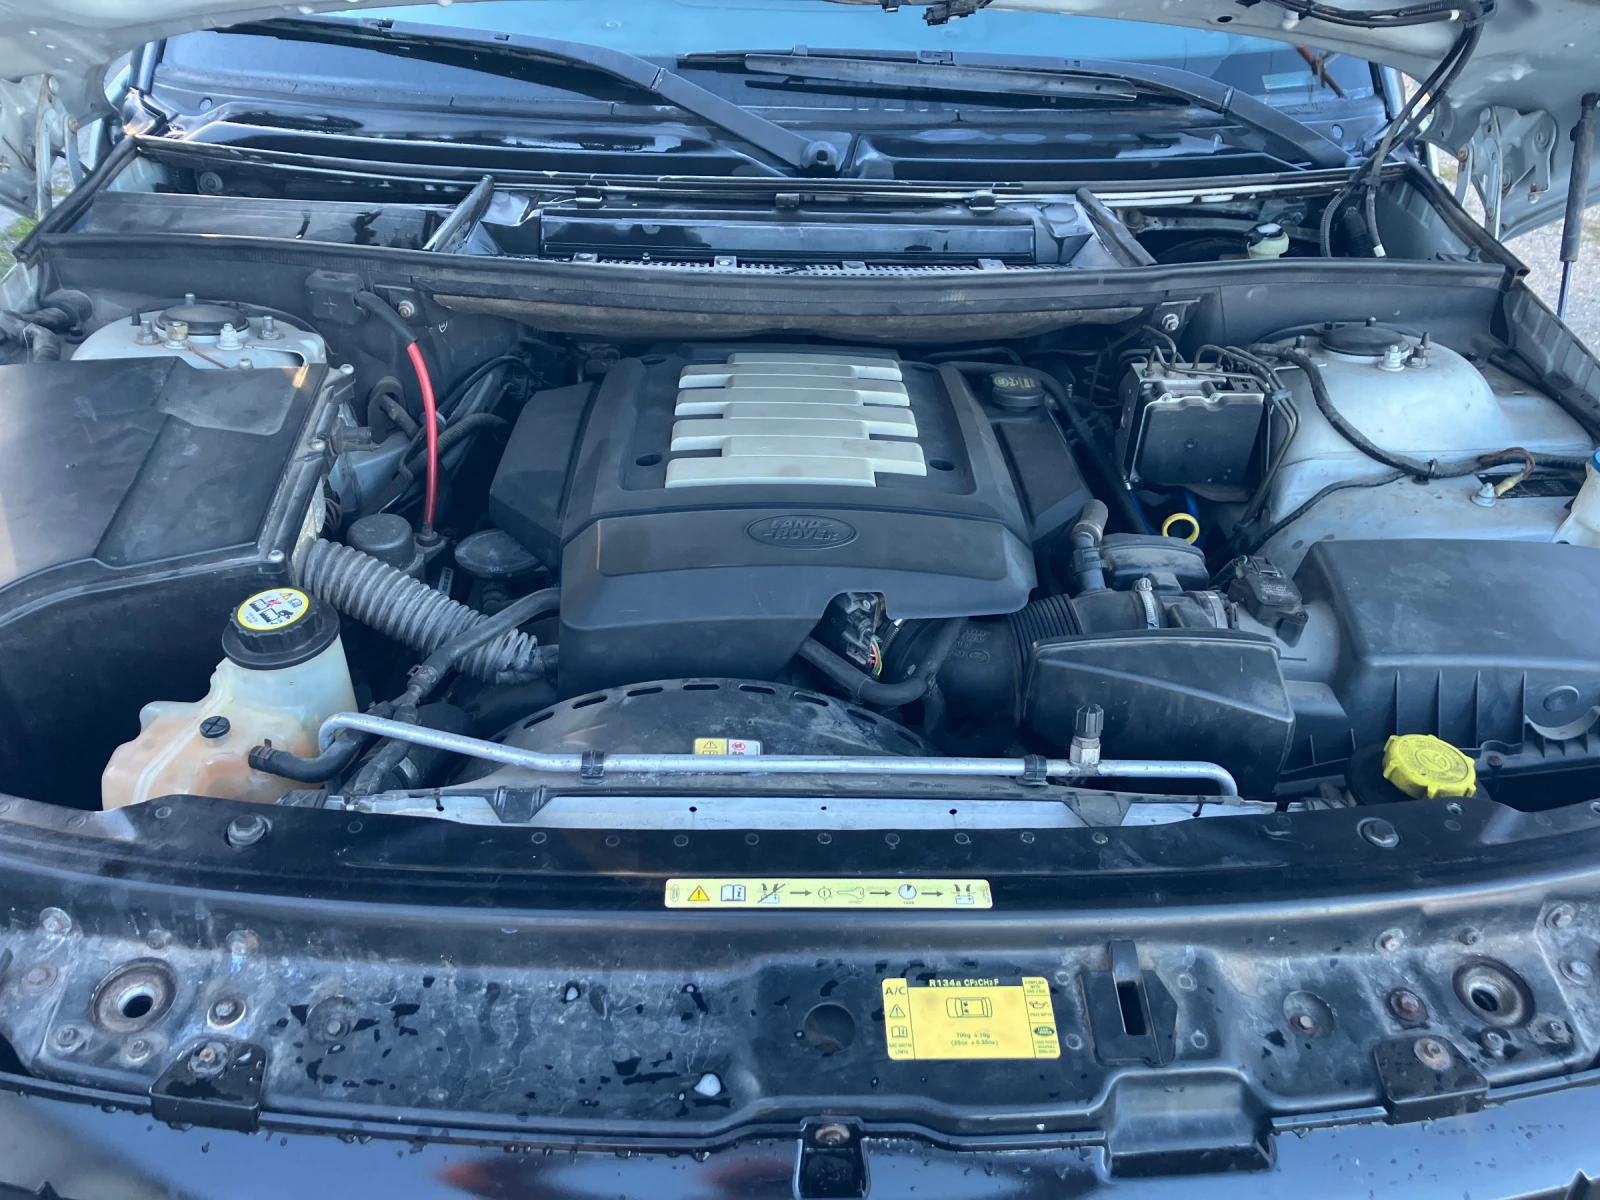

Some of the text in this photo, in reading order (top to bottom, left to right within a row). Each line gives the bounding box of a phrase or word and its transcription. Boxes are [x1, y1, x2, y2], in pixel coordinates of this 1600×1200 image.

[770, 519, 821, 529] LAND
[774, 527, 840, 540] ROVER
[885, 987, 906, 996] A/C
